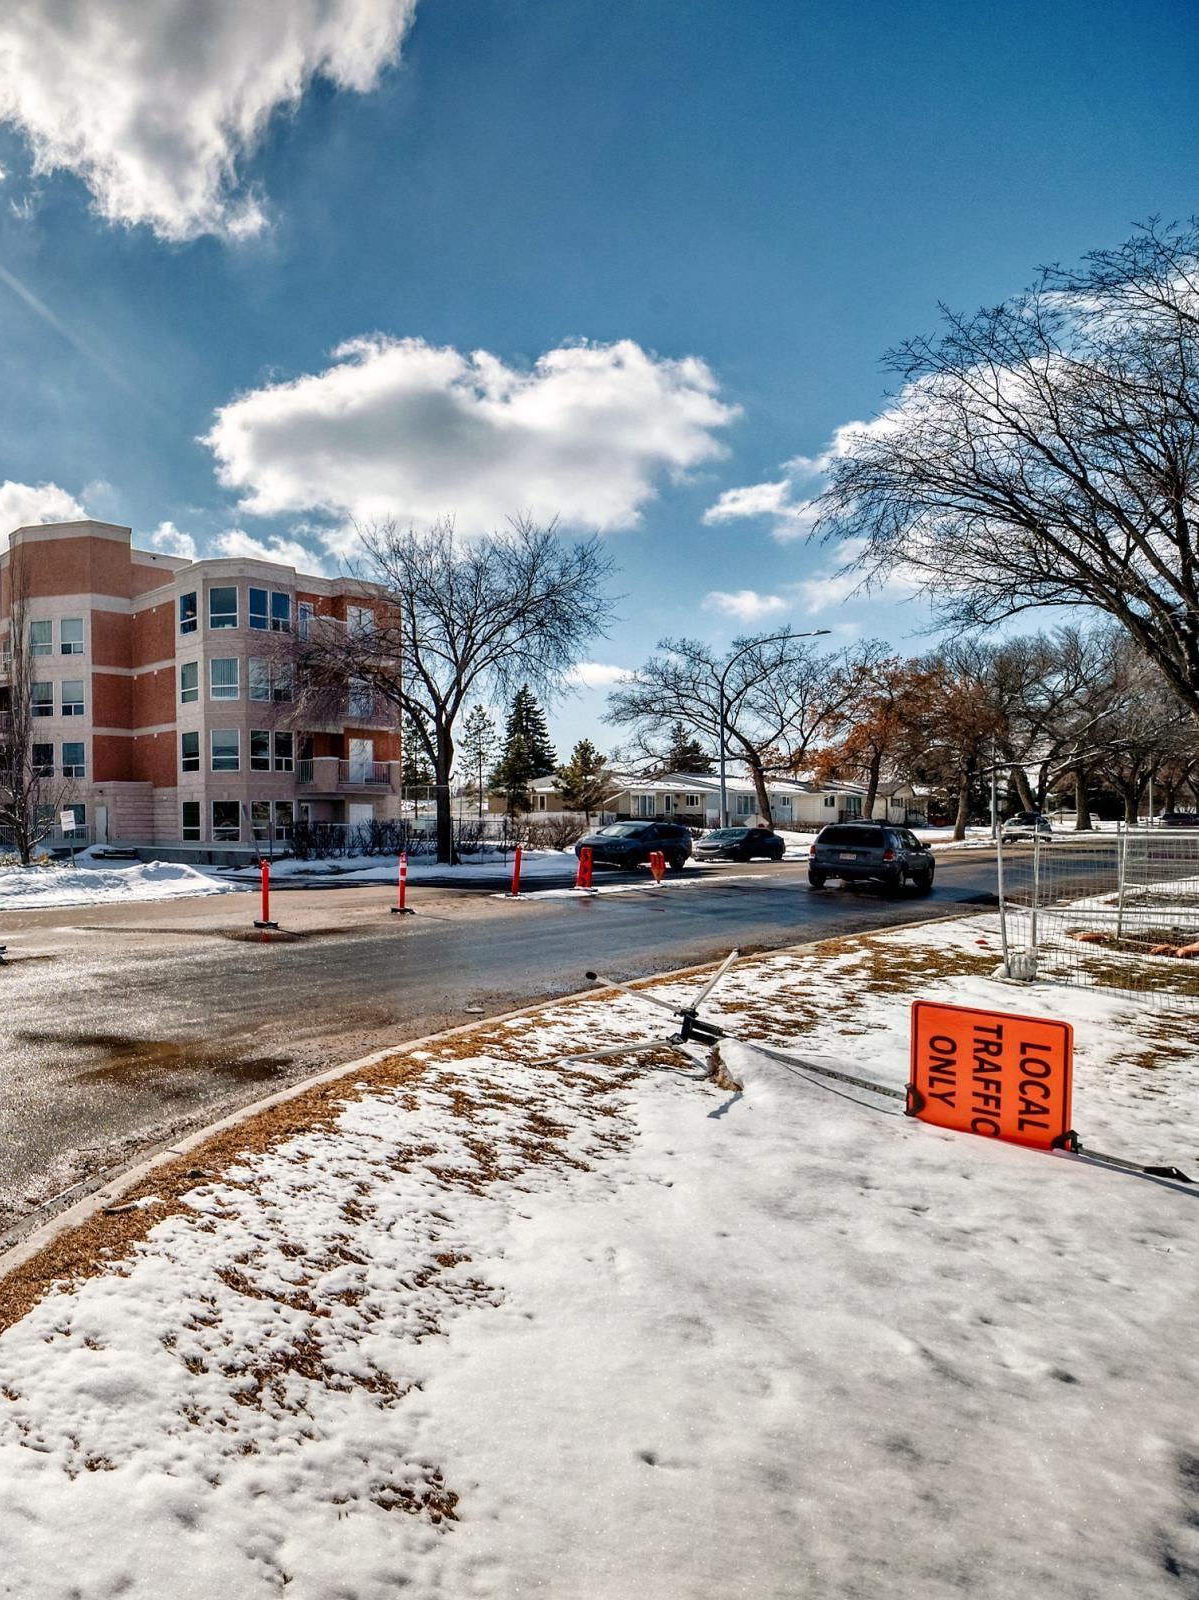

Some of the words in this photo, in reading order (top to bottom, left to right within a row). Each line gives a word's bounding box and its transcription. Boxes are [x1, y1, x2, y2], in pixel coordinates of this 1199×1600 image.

[928, 1035, 958, 1109] ONLY
[971, 1024, 1003, 1137] TRAFFIC
[1018, 1041, 1052, 1132] LOCAL
